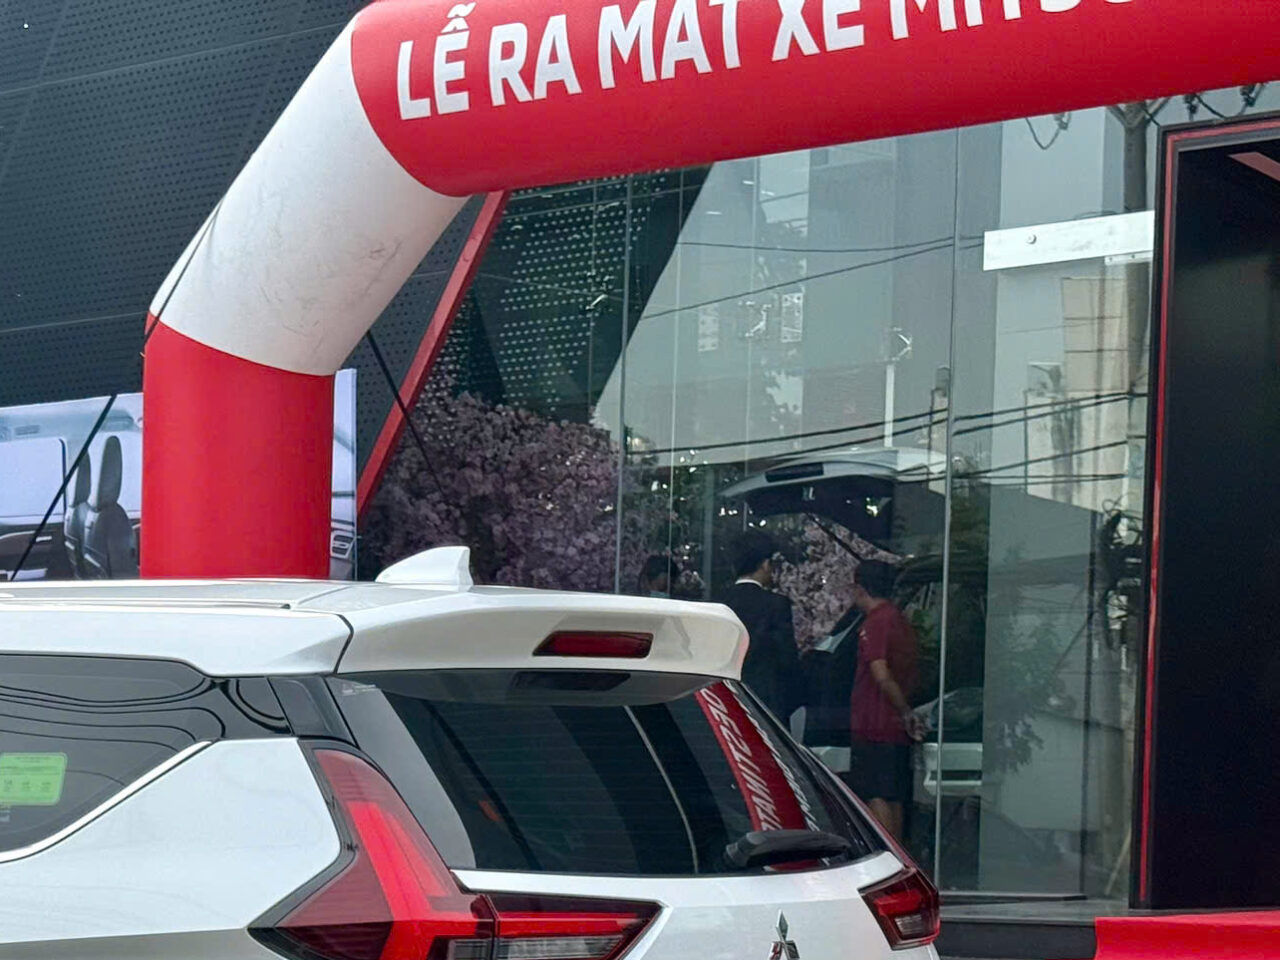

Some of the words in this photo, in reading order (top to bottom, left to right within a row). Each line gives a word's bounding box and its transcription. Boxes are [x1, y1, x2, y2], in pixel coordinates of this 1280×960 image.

[396, 3, 475, 121] LỄ
[488, 14, 583, 107] RA
[771, 0, 864, 61] XE
